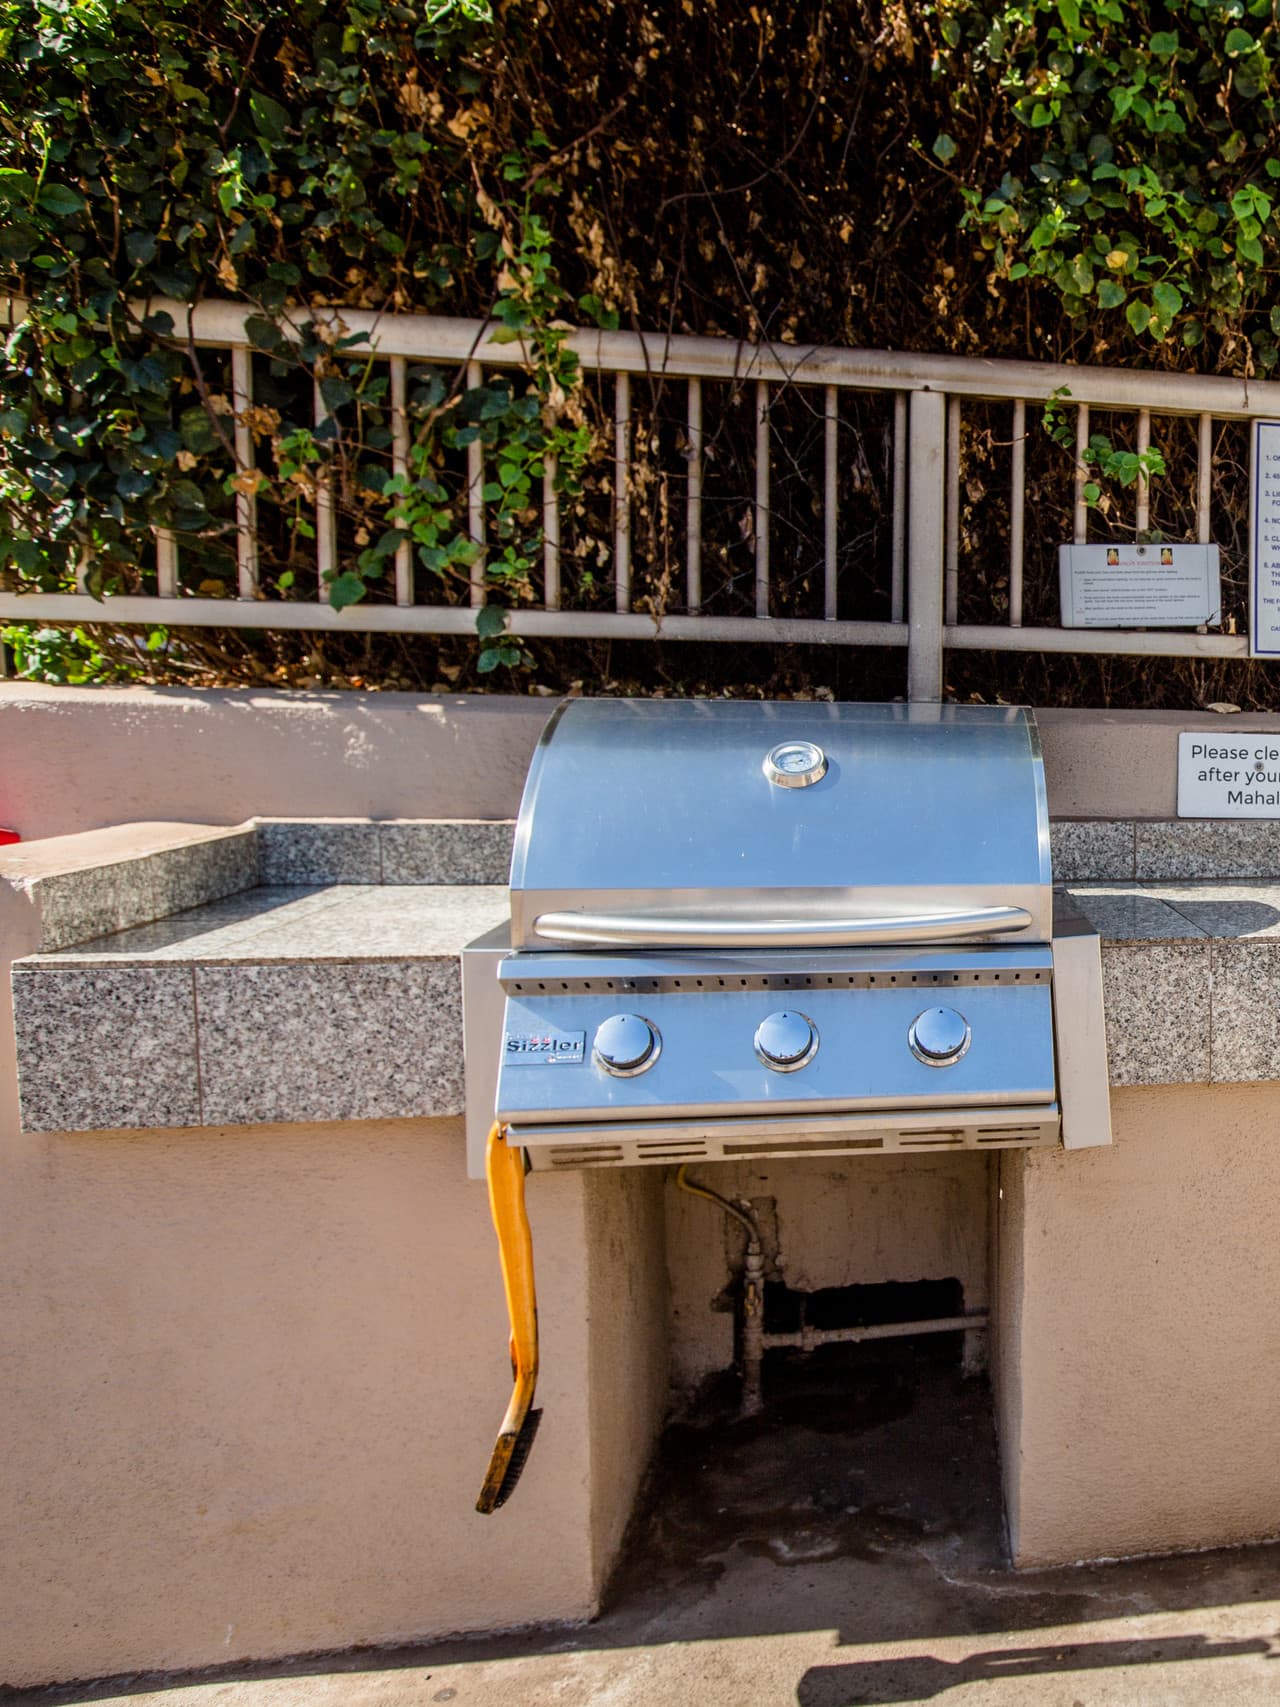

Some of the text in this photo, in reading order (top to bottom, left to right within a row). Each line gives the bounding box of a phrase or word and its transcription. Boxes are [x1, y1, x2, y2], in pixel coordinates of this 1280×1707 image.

[1192, 745, 1249, 760] Please
[1198, 767, 1240, 782] after
[507, 1037, 582, 1052] Sizzler
